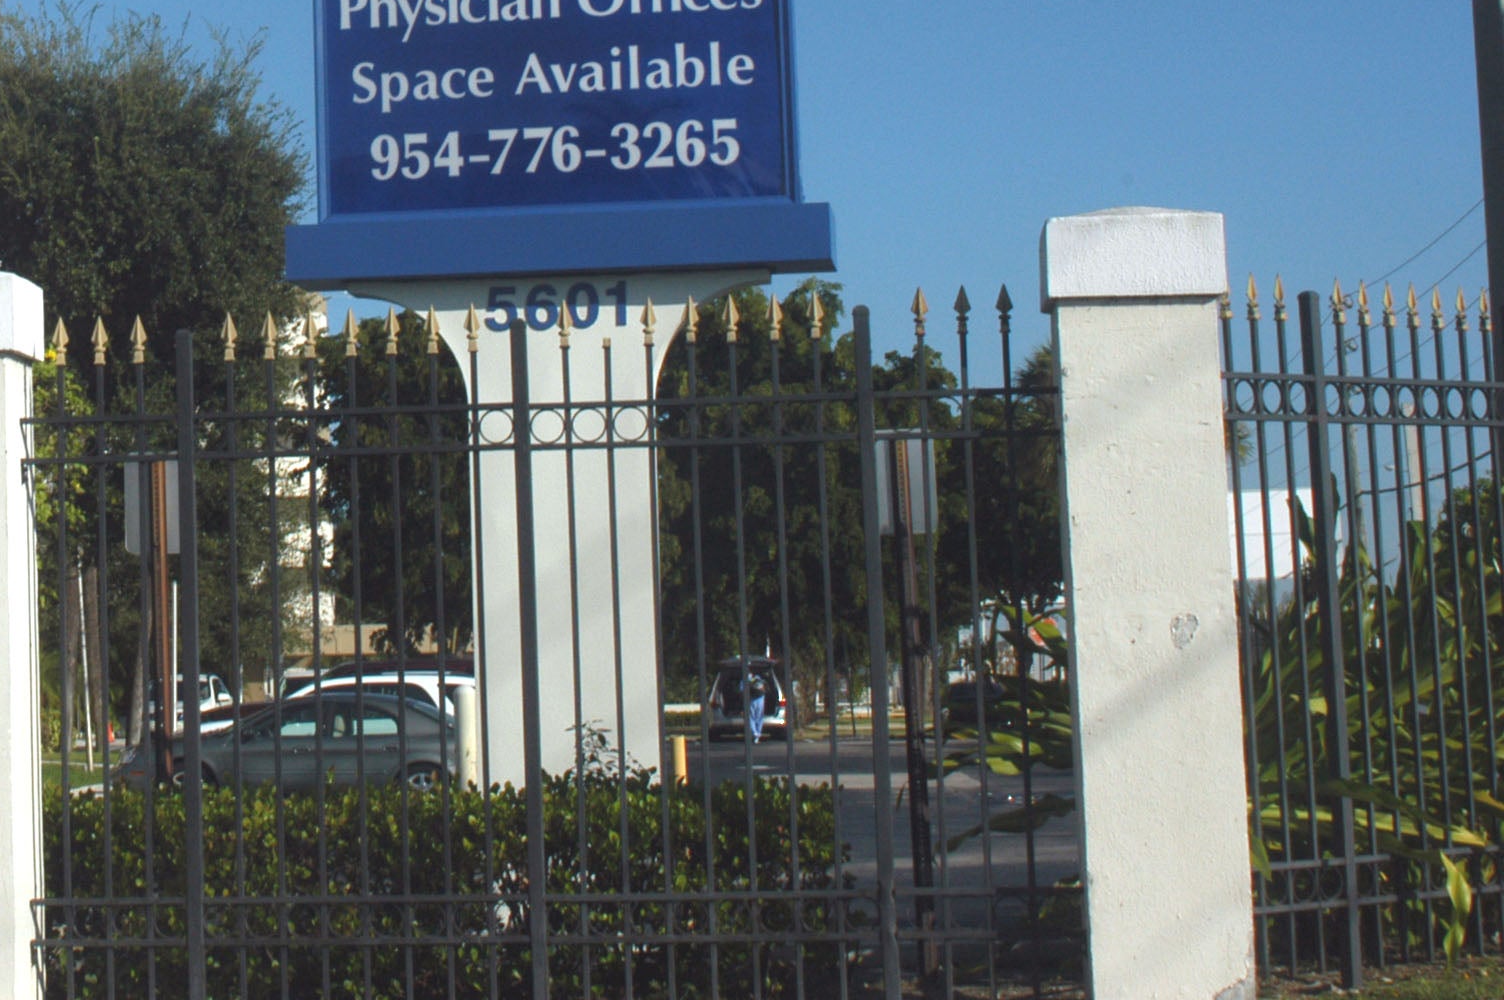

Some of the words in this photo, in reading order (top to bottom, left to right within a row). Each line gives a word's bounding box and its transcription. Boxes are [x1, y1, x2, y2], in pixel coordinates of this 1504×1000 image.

[352, 62, 494, 112] Space
[515, 41, 755, 95] Available
[370, 118, 740, 180] 954-776-3265
[483, 281, 628, 331] 5601
